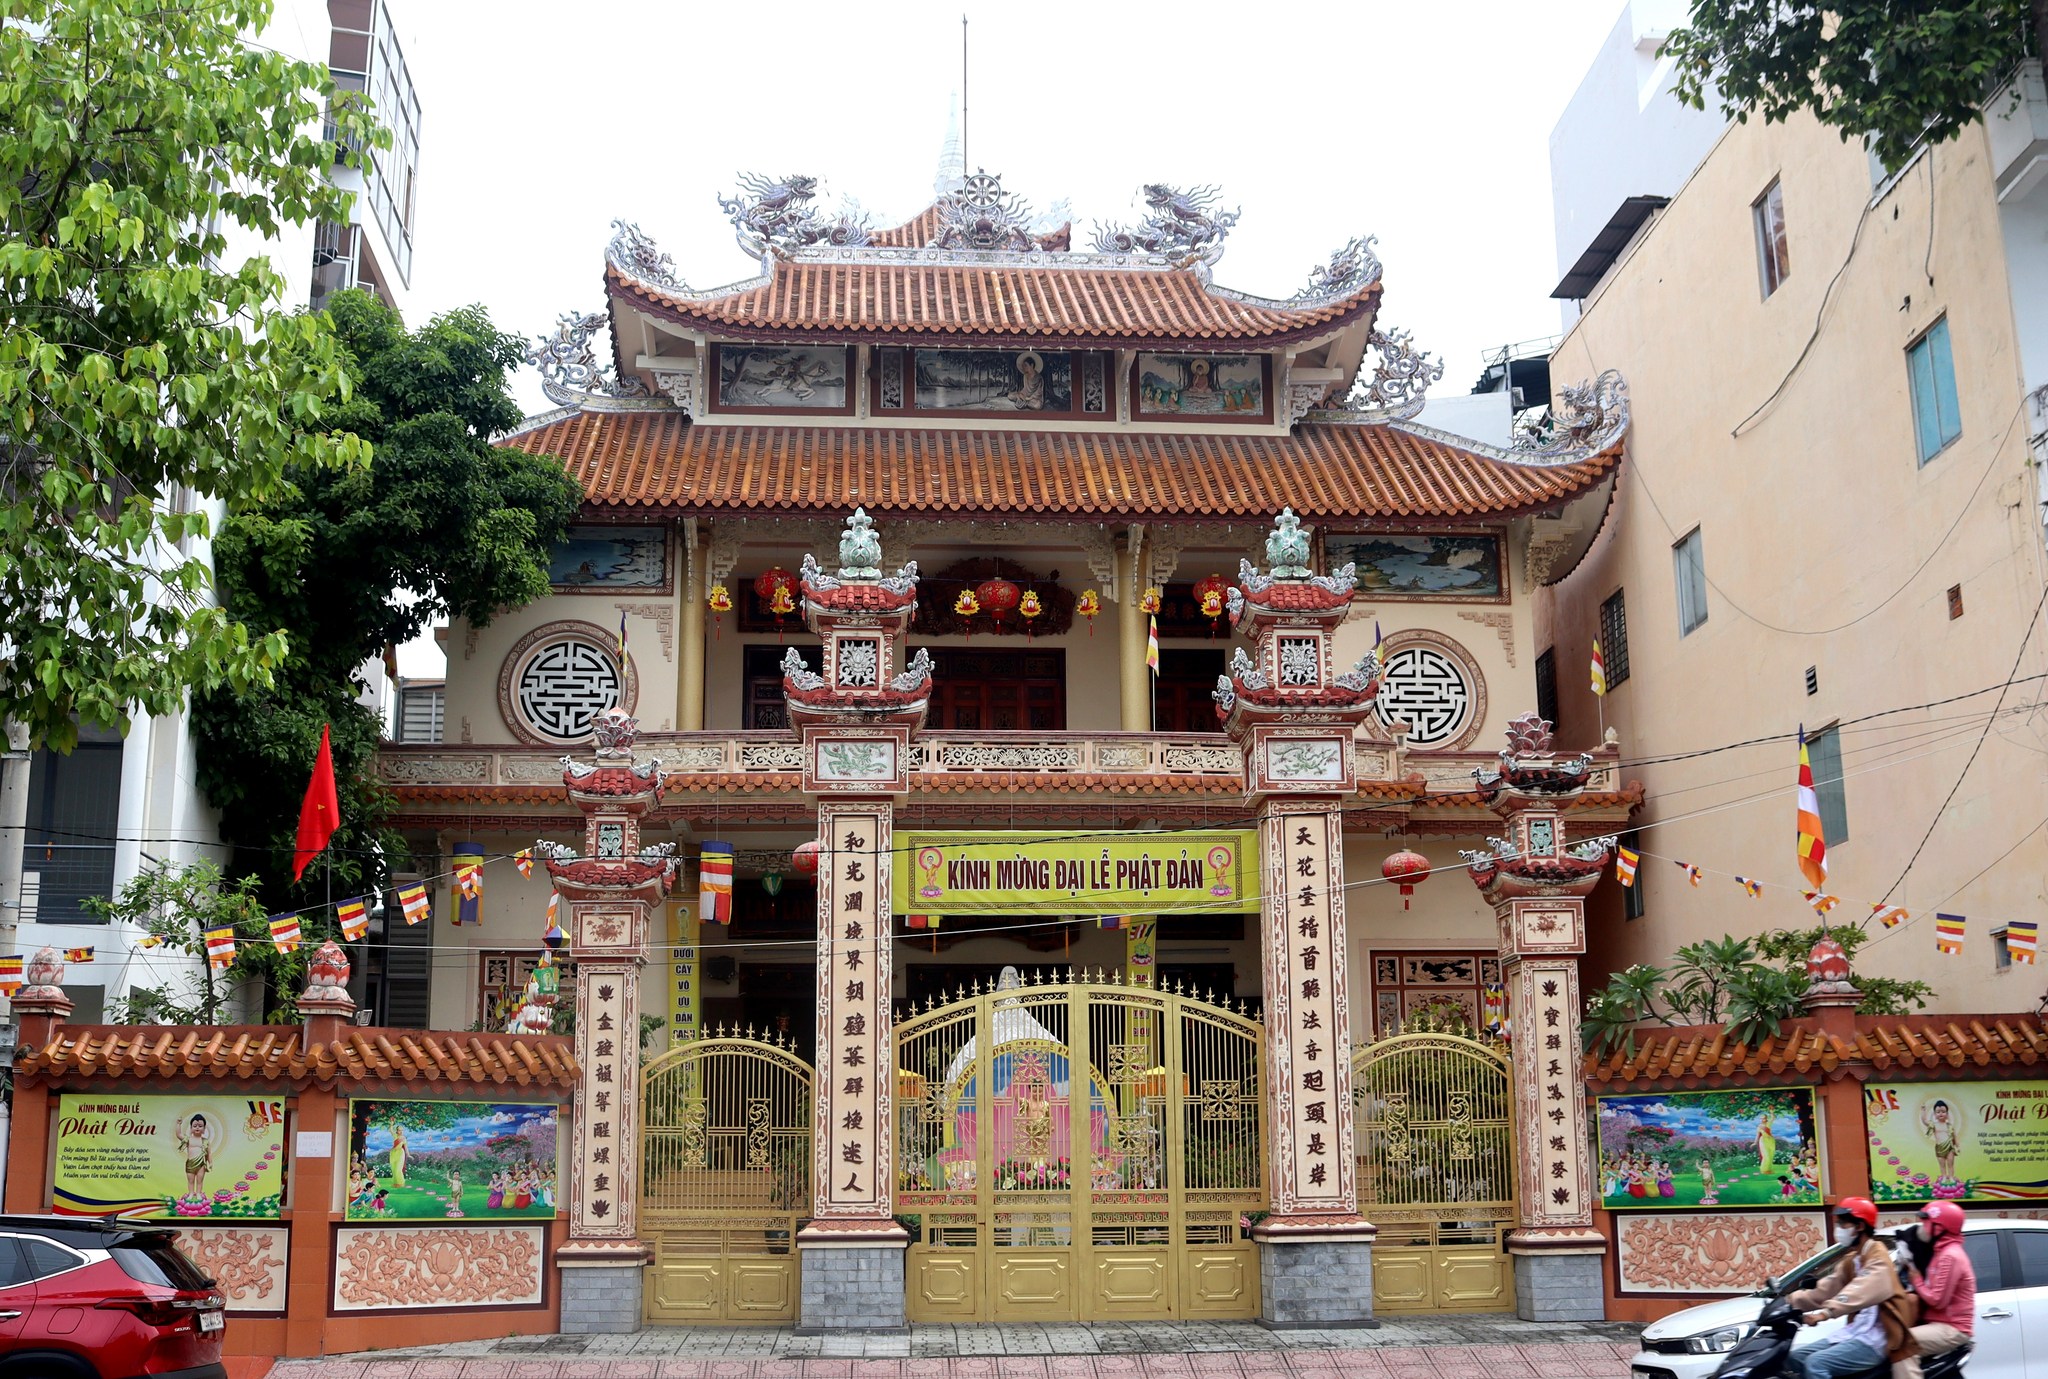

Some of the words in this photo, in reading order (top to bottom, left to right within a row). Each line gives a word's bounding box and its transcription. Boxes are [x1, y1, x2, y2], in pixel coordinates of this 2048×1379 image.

[948, 853, 990, 890] KÍNH
[997, 853, 1050, 890] MỪNG
[1055, 859, 1085, 896] ĐẠI
[1091, 849, 1110, 890] LỄ
[1116, 853, 1161, 896] PHẬT
[1166, 849, 1203, 889] ĐẢN
[673, 947, 694, 958] DƯỚI
[675, 963, 692, 974] CÂY
[678, 980, 690, 990] VÔ
[678, 996, 690, 1006] ƯU
[78, 1102, 95, 1113] KÍNH
[97, 1103, 117, 1113] MỪNG
[118, 1105, 131, 1115] ĐẠI
[1979, 1103, 2026, 1124] Phật
[58, 1117, 108, 1138] Phật
[114, 1117, 157, 1136] Đản
